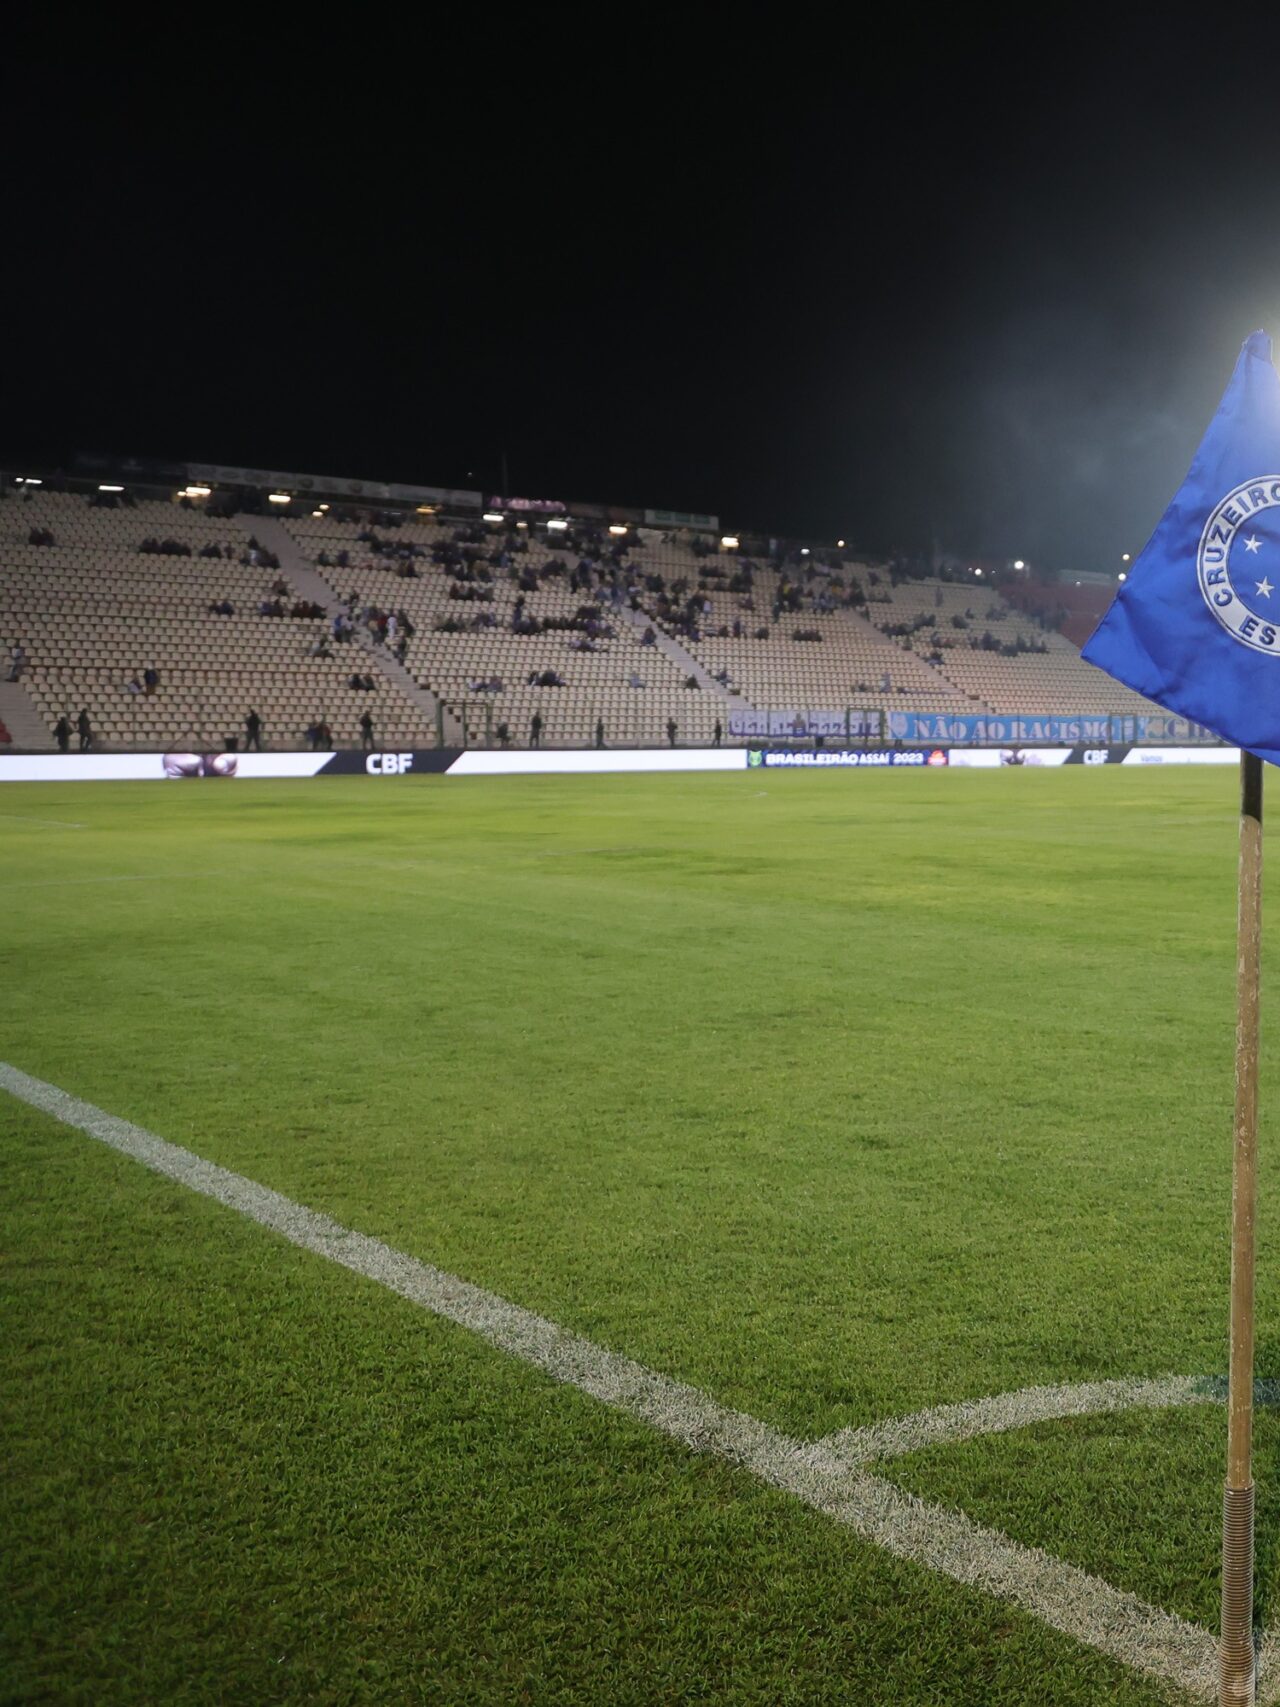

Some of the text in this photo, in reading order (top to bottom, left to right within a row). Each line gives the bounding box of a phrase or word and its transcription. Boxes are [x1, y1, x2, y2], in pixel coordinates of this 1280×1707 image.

[914, 716, 967, 738] NÃO
[972, 720, 1005, 738] AO
[1010, 719, 1114, 738] RACISMO
[366, 753, 413, 774] CBF
[766, 751, 858, 765] BRASILEIRÃO
[893, 752, 924, 764] 2023
[1083, 749, 1109, 764] CBF
